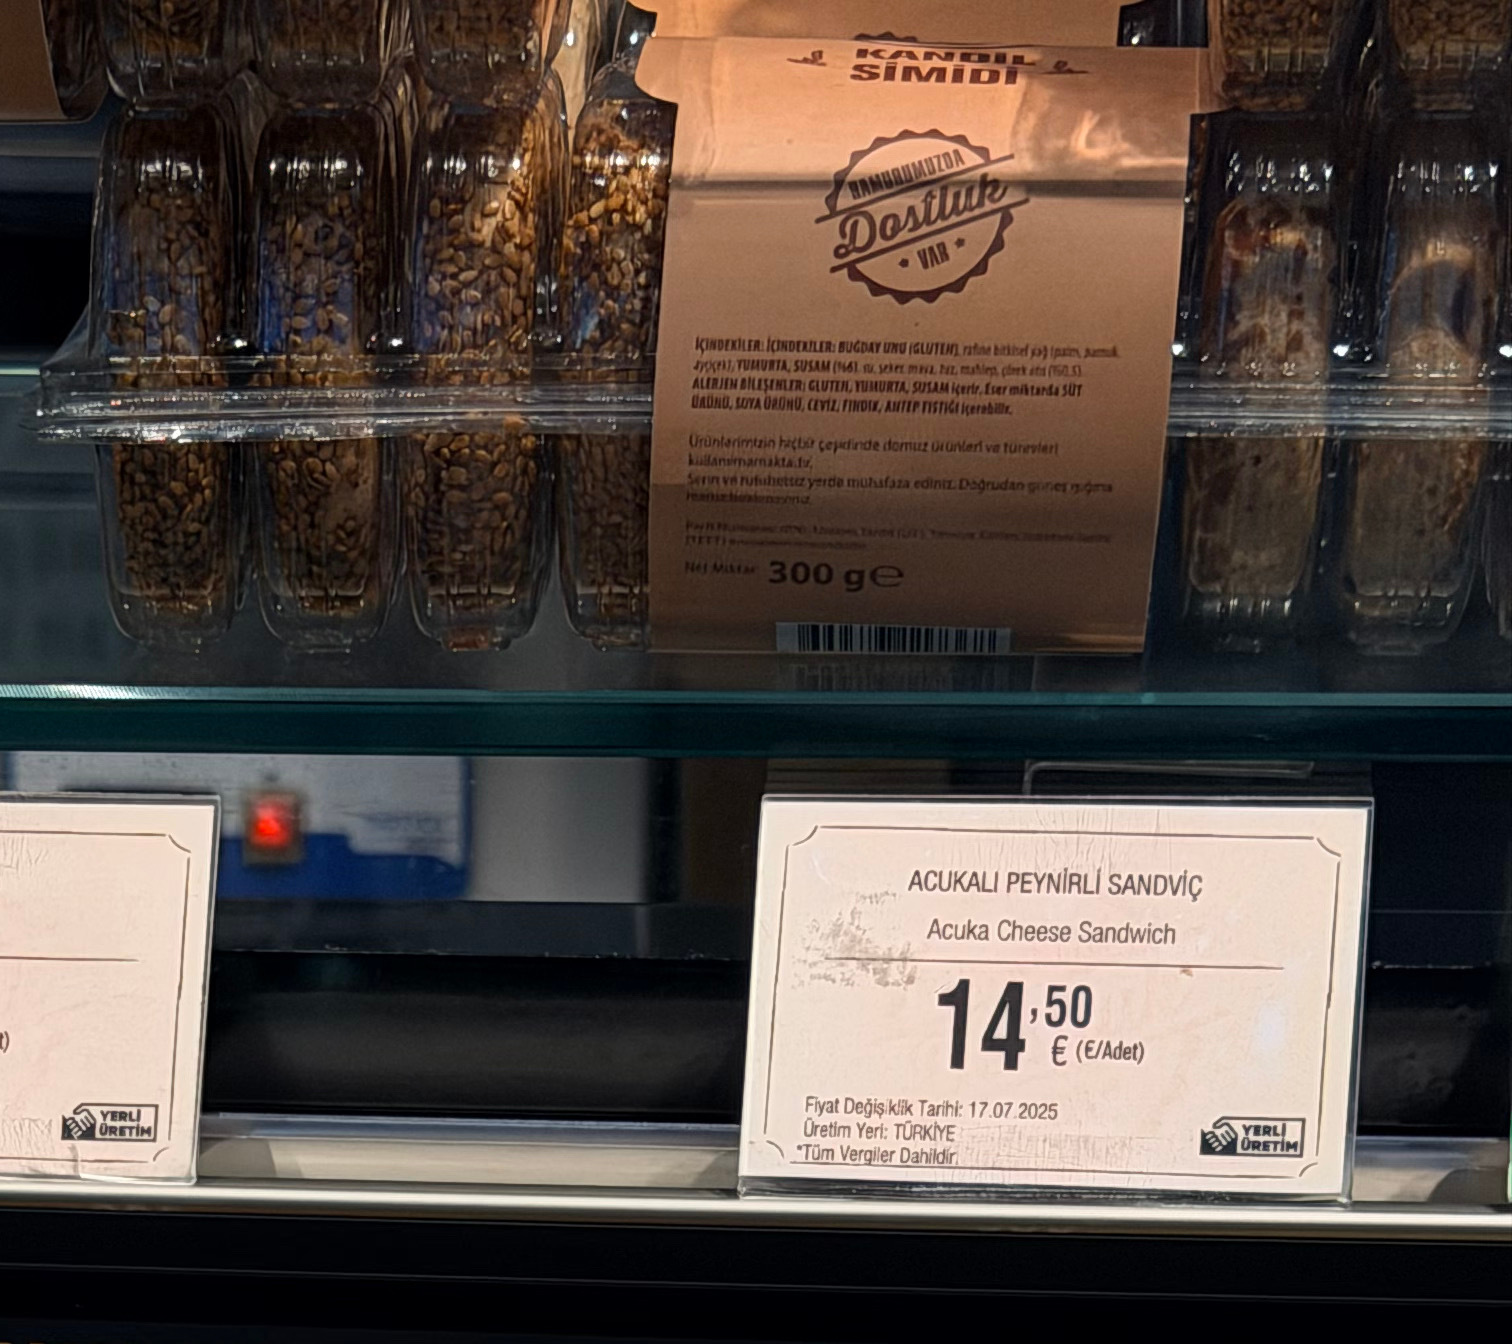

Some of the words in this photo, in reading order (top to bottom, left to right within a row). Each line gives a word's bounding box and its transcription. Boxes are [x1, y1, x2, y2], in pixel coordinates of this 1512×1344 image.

[855, 48, 1036, 66] KANDİL
[849, 61, 1018, 86] SİMİDİ
[833, 172, 1008, 260] Dostluk
[917, 241, 950, 270] VAR
[794, 359, 831, 374] SUSAM
[913, 380, 949, 395] SUSAM
[768, 560, 834, 585] 300
[908, 868, 999, 895] ACUKALI
[1006, 866, 1102, 897] PEYNİRLİ
[1107, 866, 1204, 901] SANDVİÇ
[926, 918, 990, 942] Acuka
[997, 920, 1072, 944] Cheese
[1077, 920, 1177, 946] Sandwich
[1051, 1034, 1068, 1067] €
[1075, 1039, 1146, 1065] (€/Adet)
[99, 1108, 142, 1122] YERLİ
[805, 1096, 840, 1116] Fiyat
[844, 1097, 914, 1118] Değişiklik
[918, 1099, 964, 1118] Tarihi:
[969, 1101, 1058, 1120] 17.07.2025
[99, 1122, 152, 1137] ÜRETİM
[803, 1117, 852, 1138] Üretim
[856, 1121, 889, 1140] Yeri:
[894, 1120, 956, 1142] TÜRKİYE
[1241, 1122, 1287, 1137] YERLİ
[840, 1146, 896, 1166] Vergiler
[900, 1147, 959, 1165] Dahildir.
[1241, 1136, 1299, 1152] ÜRETİM
